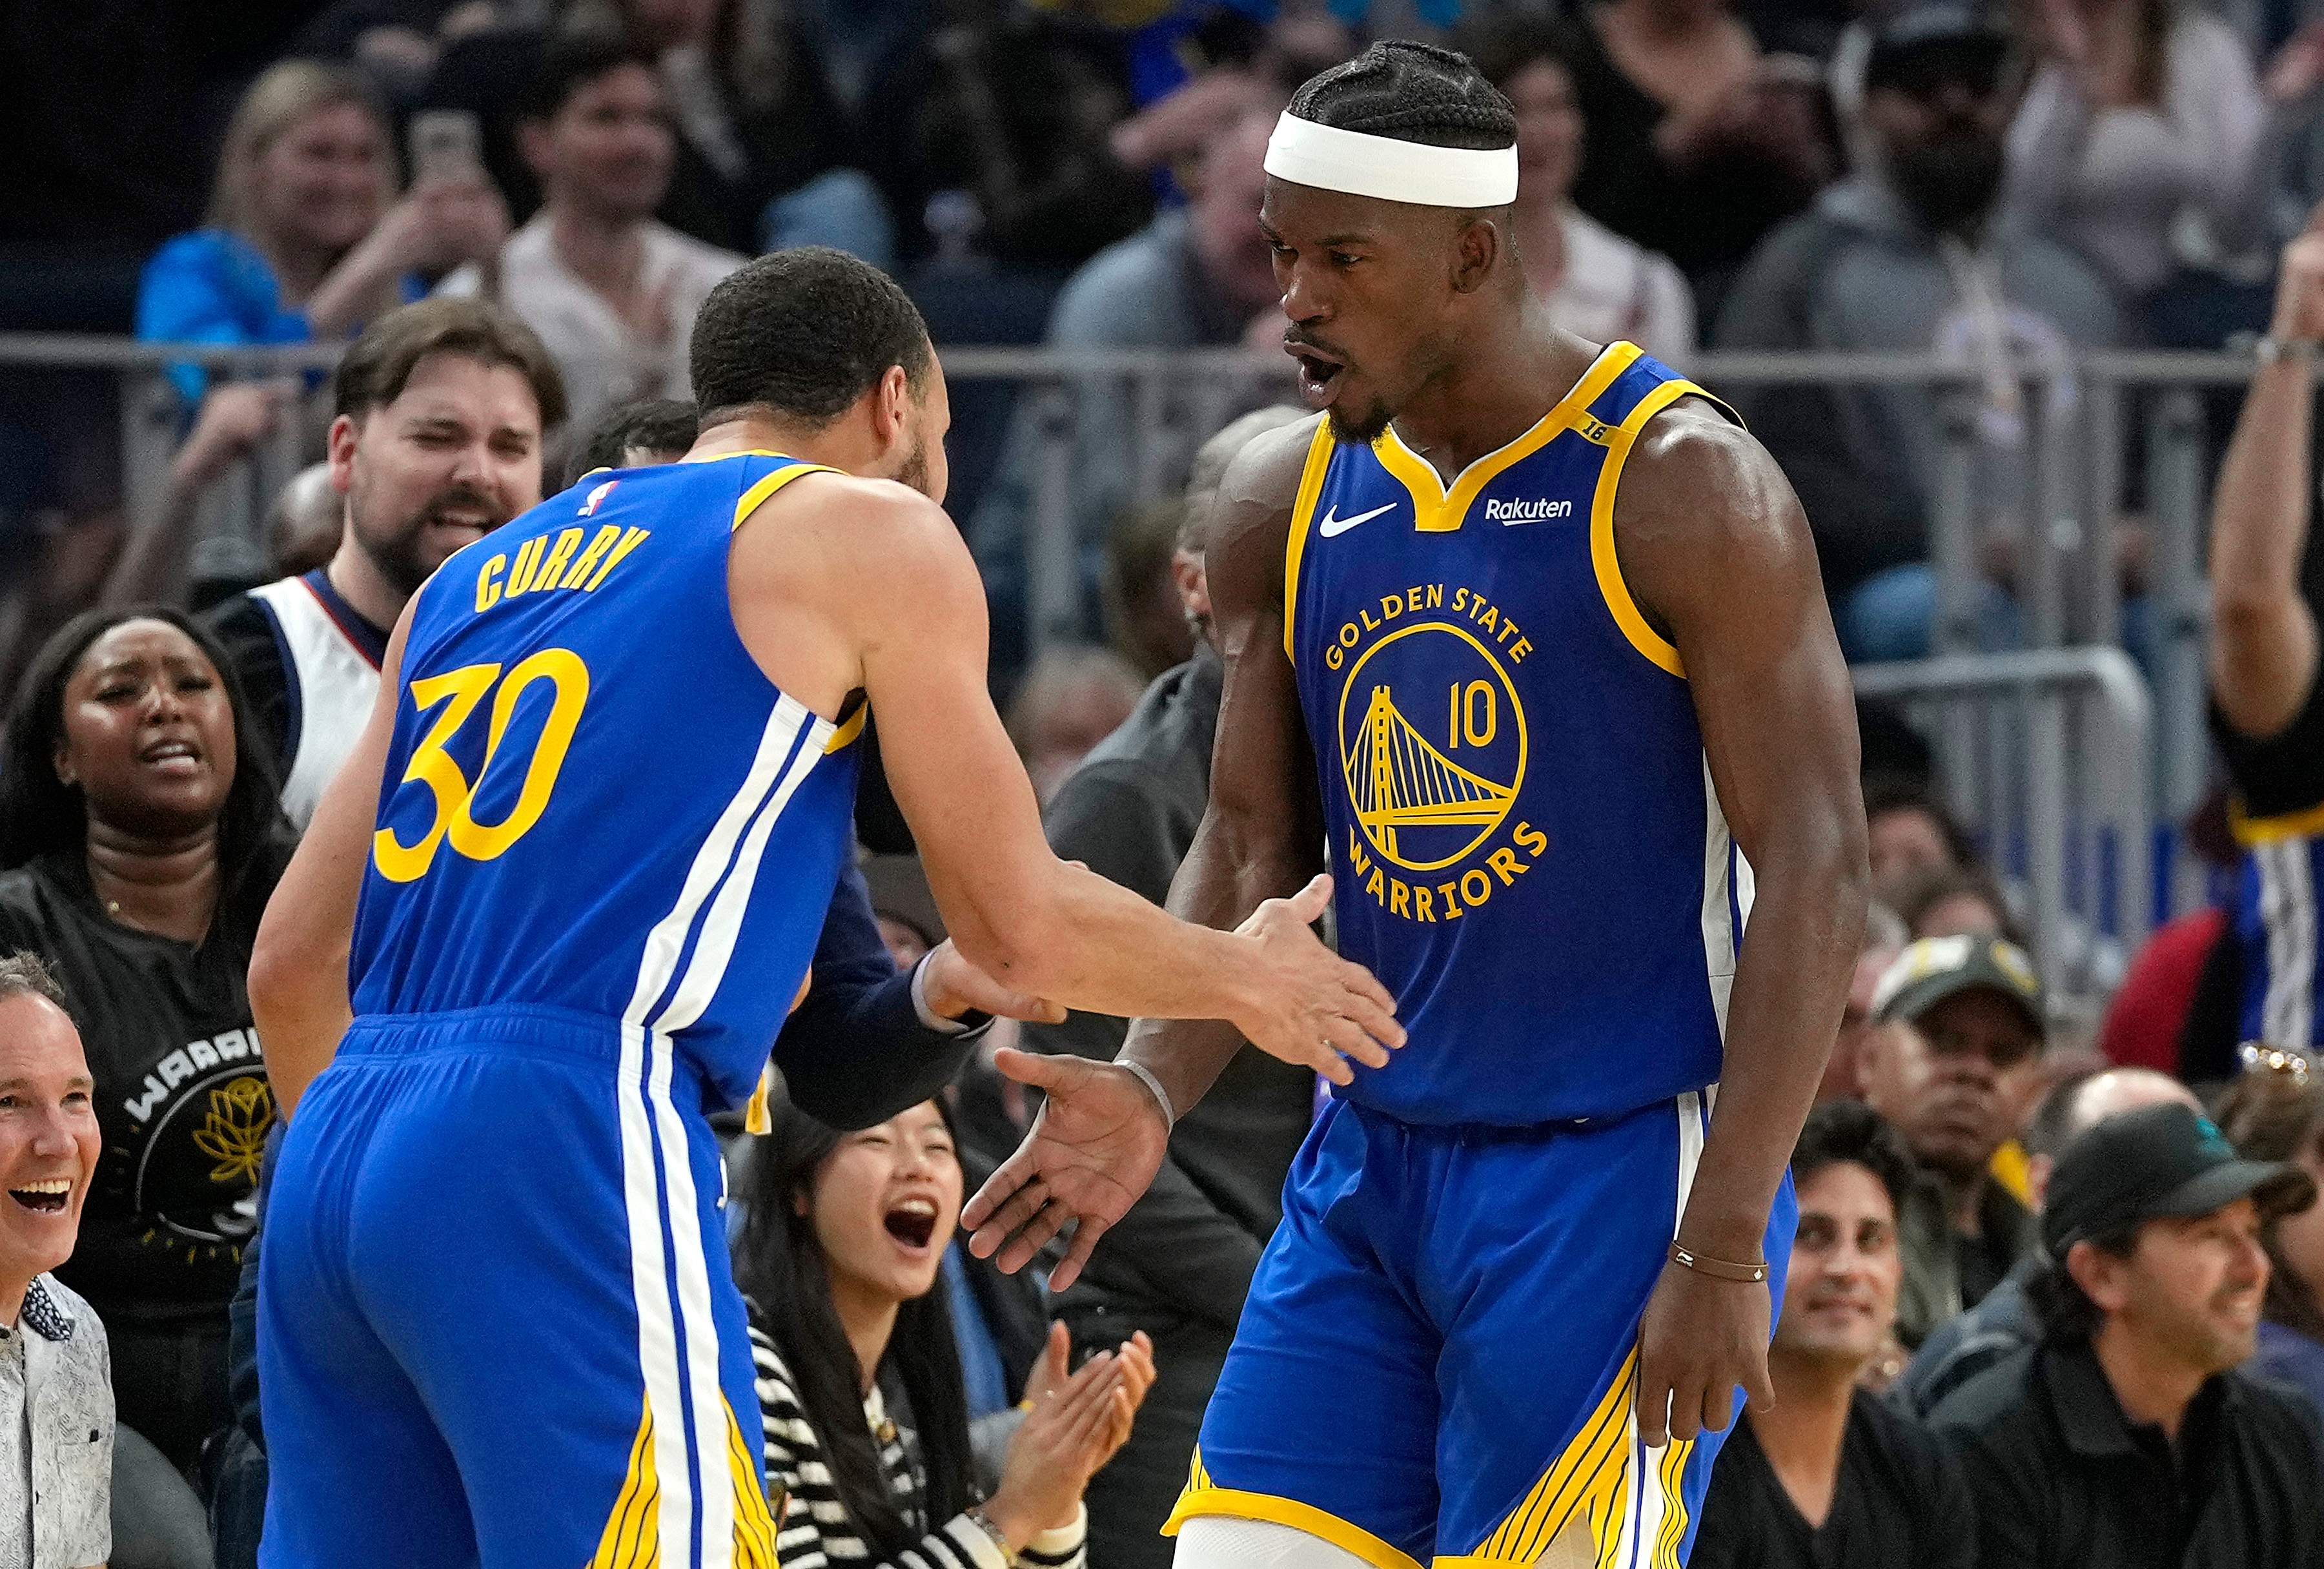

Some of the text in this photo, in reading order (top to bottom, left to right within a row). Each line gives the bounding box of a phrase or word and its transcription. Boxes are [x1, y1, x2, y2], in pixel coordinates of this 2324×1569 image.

[1582, 421, 1607, 440] 16
[1485, 497, 1573, 520] Rakuten
[475, 524, 650, 613] CURRY
[1325, 583, 1534, 671] GOLDEN STATE
[1449, 679, 1497, 749] 10
[374, 648, 590, 883] 30
[1349, 821, 1548, 923] WARRIORS
